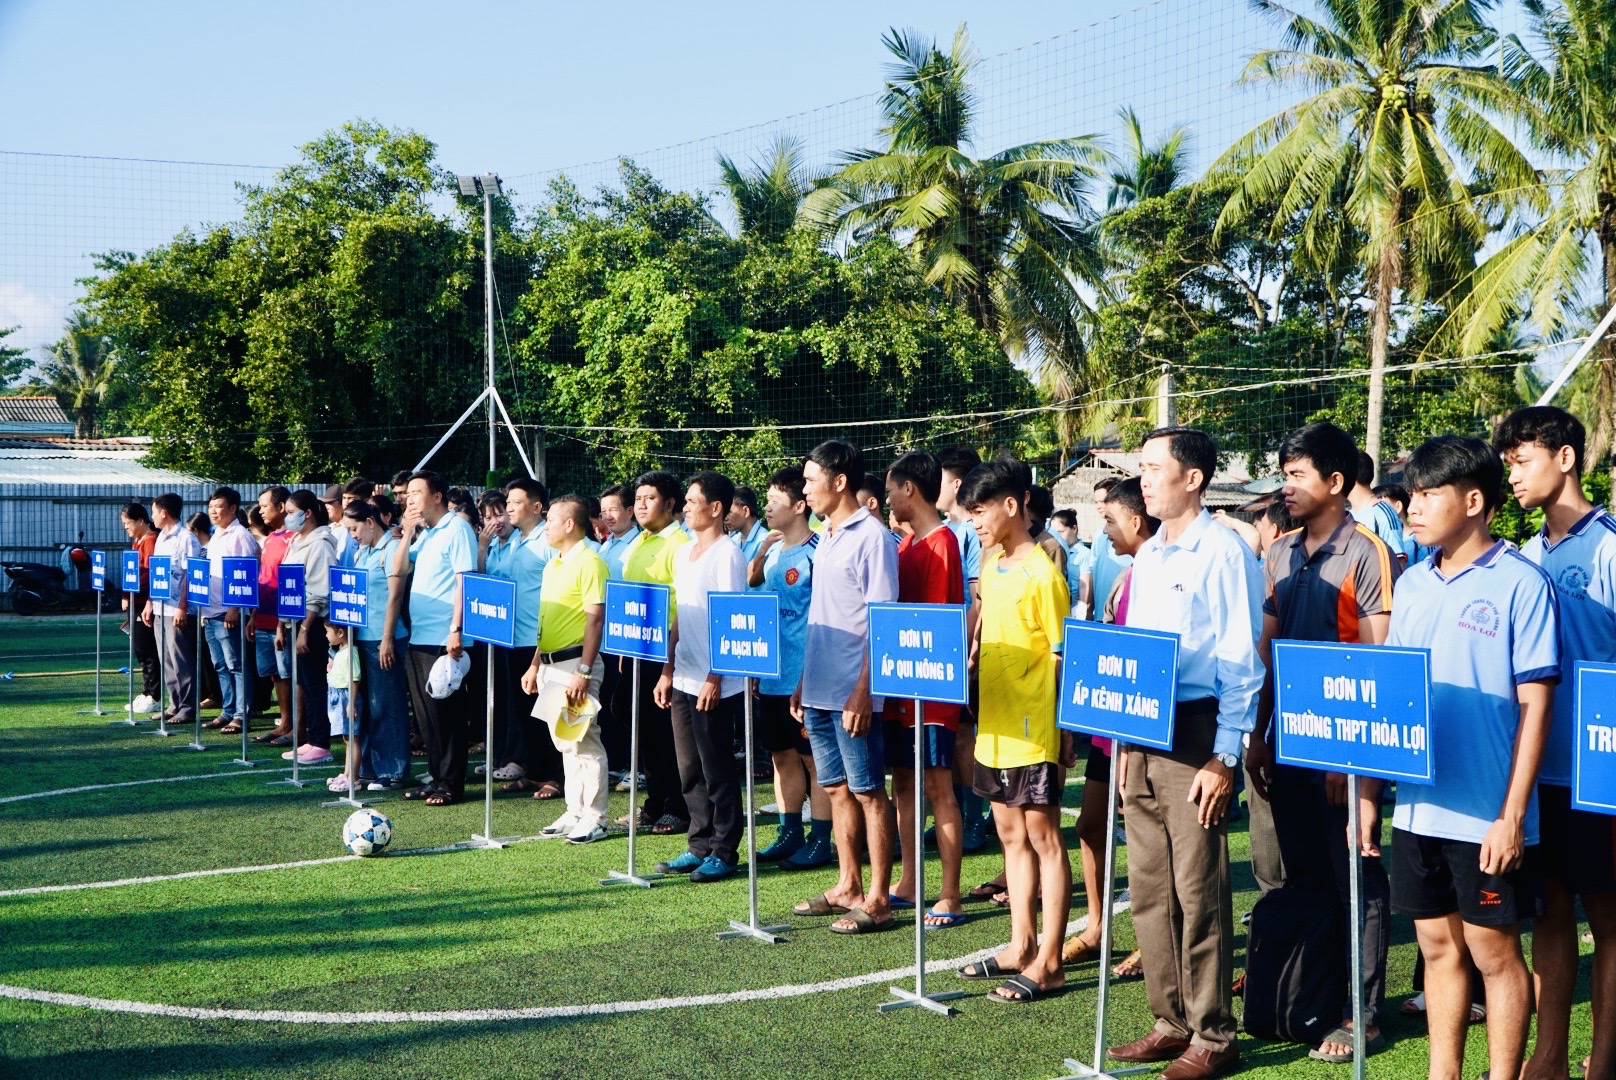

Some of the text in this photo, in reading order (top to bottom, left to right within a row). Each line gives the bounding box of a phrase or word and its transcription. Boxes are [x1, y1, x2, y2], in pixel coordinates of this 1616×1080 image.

[479, 602, 496, 618] TRỌNG
[497, 605, 507, 620] TÀI
[624, 601, 646, 620] ĐƠN VỊ
[730, 613, 755, 633] ĐƠN VỊ
[609, 622, 663, 644] BCH QUÂN SỰ XÃ
[899, 628, 933, 653] ĐƠN VỊ
[720, 635, 731, 654] ẤP
[731, 640, 751, 659] RẠCH
[881, 653, 954, 681] ẤP QUI NÔNG B
[1098, 654, 1138, 684] ĐƠN VỊ
[1072, 679, 1160, 719] ẤP KÊNH XÁNG
[1323, 676, 1376, 709] ĐƠN VỊ
[1282, 709, 1426, 755] TRƯỜNG THPT HÒA LỢI
